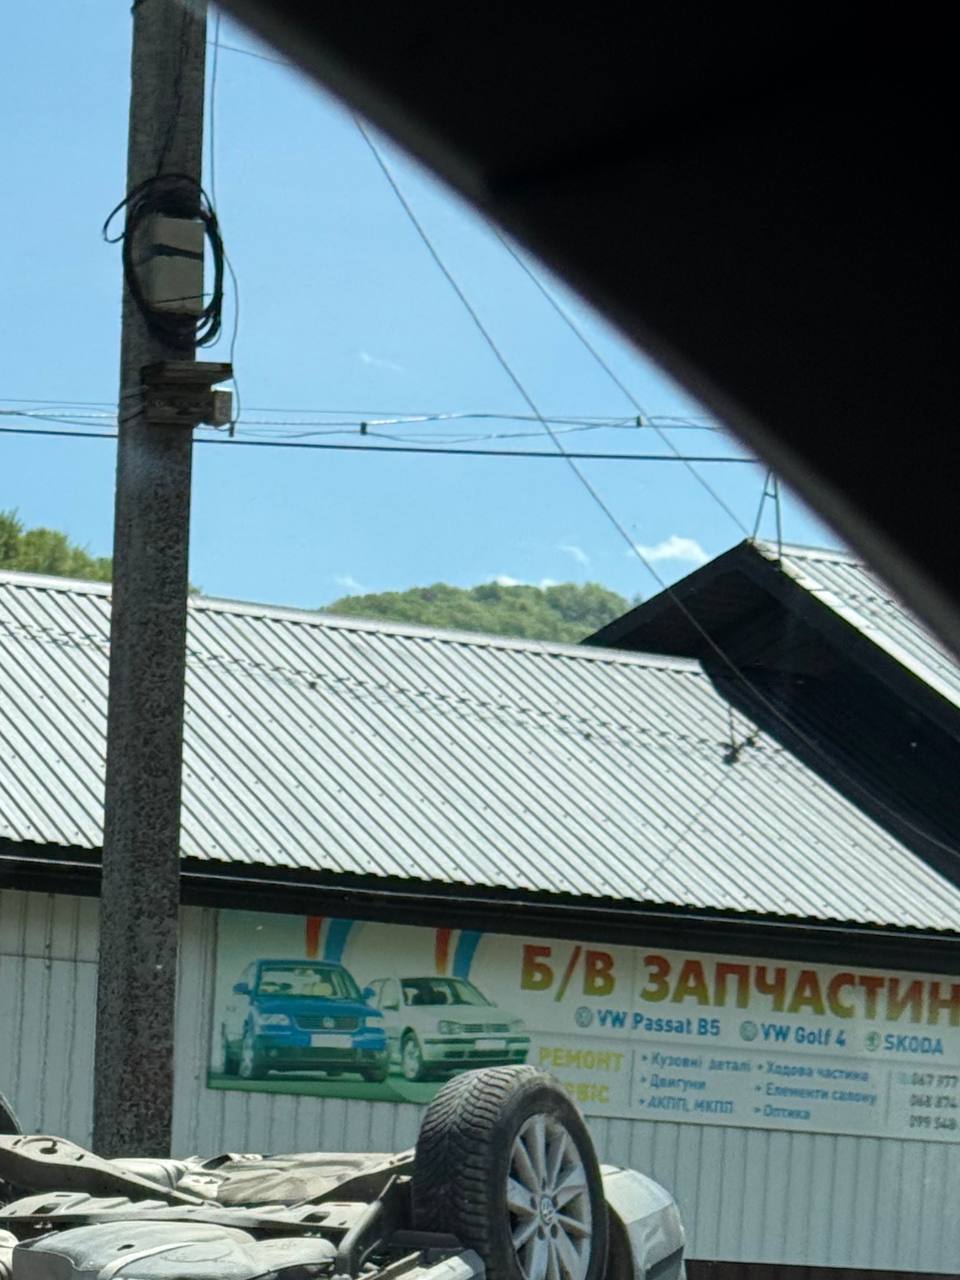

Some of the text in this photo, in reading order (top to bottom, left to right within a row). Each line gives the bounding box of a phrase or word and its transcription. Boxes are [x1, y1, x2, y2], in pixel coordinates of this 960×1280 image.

[521, 944, 616, 1002] Б/В
[597, 1009, 721, 1037] VW Passat B5
[761, 1022, 846, 1047] VW Golf 4
[884, 1034, 944, 1055] SKODA
[540, 1047, 625, 1072] РЕМОНТ
[651, 1052, 703, 1068] Кузовні
[766, 1060, 813, 1077] Ходова
[565, 1082, 609, 1104] РВІС
[650, 1073, 707, 1092] Двигуни
[766, 1083, 829, 1099] Елементи
[763, 1104, 811, 1120] Оптика
